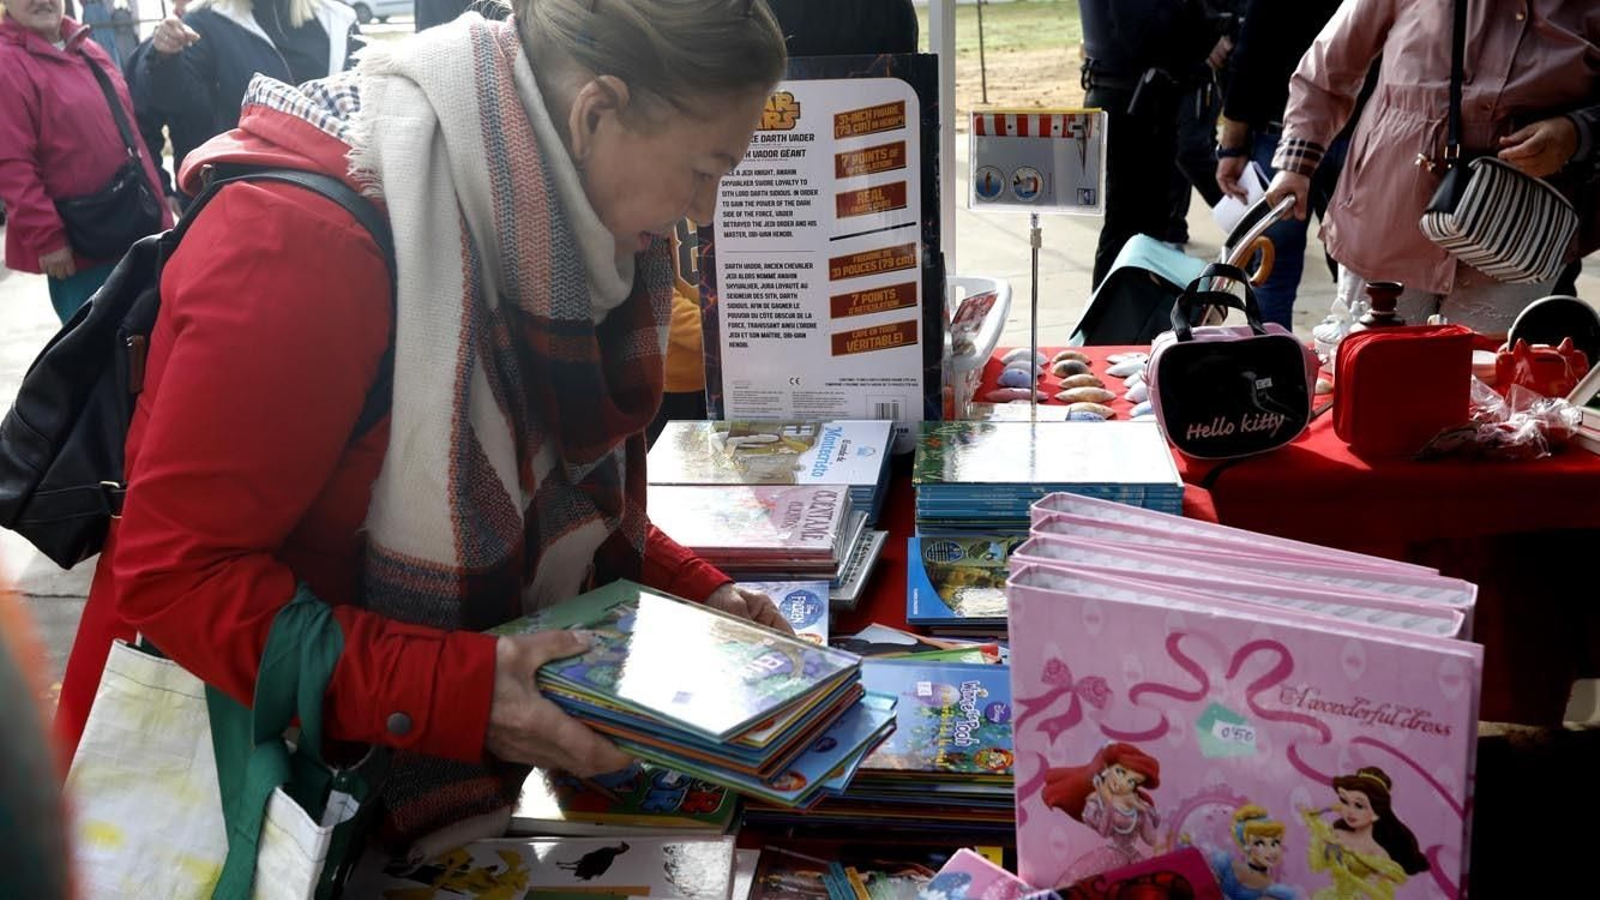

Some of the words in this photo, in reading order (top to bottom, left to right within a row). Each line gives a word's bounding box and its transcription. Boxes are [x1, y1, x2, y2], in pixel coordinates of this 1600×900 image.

[760, 133, 787, 143] DARTH
[788, 133, 815, 142] VADER
[752, 149, 779, 158] VADOR
[780, 148, 807, 158] GÉANT
[852, 149, 888, 165] POINTS
[842, 260, 877, 276] POUCES
[851, 293, 860, 306] 7
[861, 288, 897, 303] POINTS
[1186, 415, 1235, 440] Hello
[1240, 412, 1285, 438] kitty
[811, 426, 843, 477] Montecristo
[1308, 696, 1406, 727] wonderful
[1400, 706, 1453, 737] dress
[954, 720, 981, 747] Pooh
